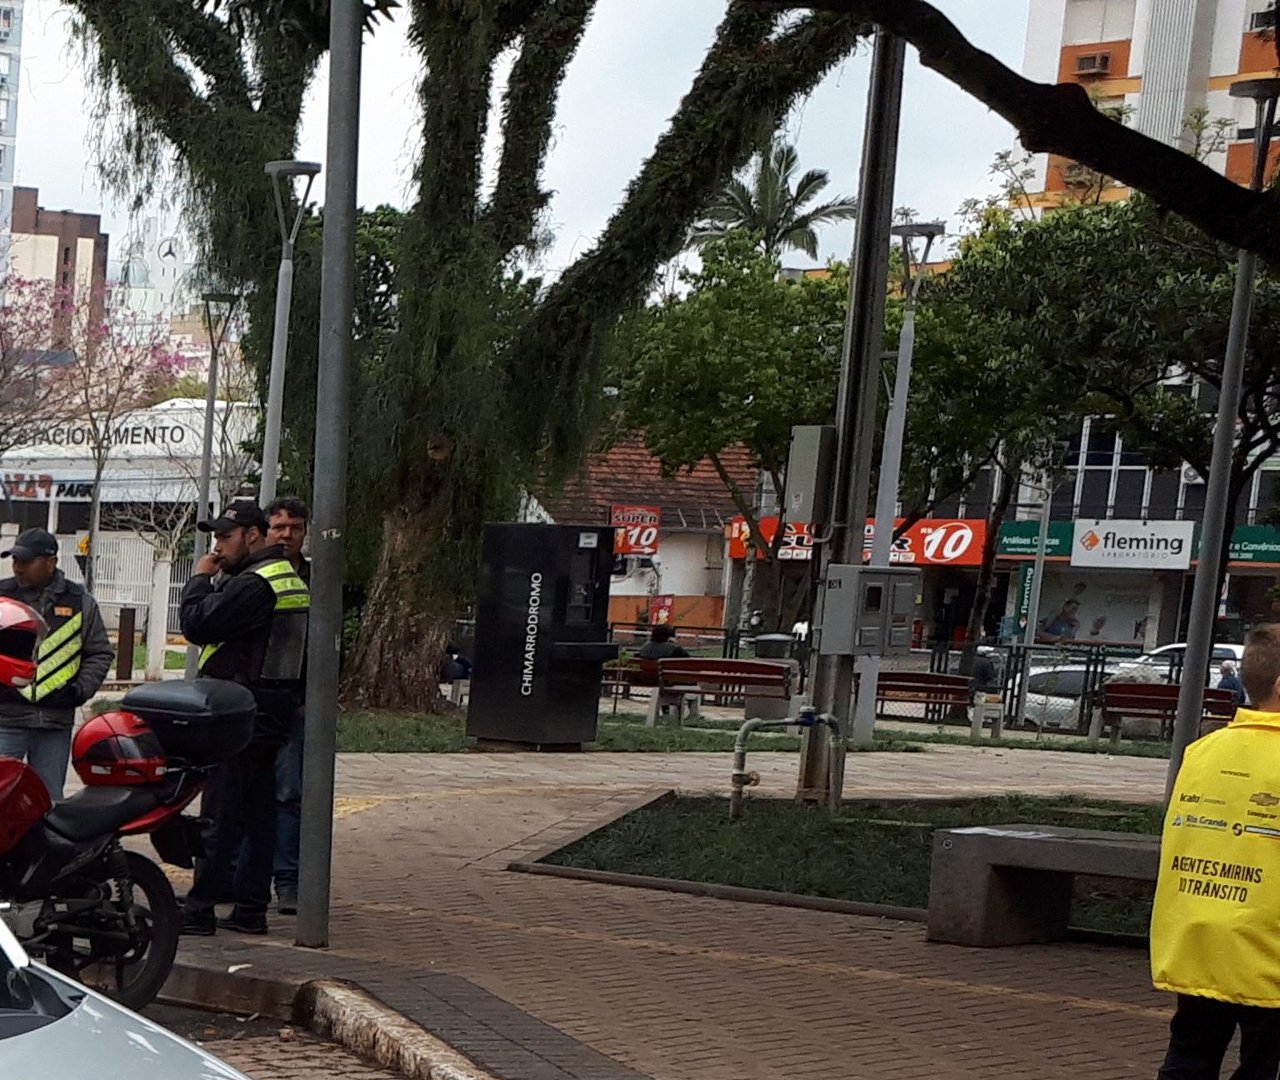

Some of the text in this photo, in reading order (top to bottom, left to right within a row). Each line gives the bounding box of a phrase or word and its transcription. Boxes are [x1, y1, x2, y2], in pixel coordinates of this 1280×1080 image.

[614, 514, 657, 523] SUPER
[628, 527, 658, 546] 10
[924, 528, 974, 560] 10
[1102, 531, 1184, 556] fleming
[521, 572, 543, 696] CHIMARRÓDROMO
[1171, 855, 1263, 884] AGENTES MIRINS
